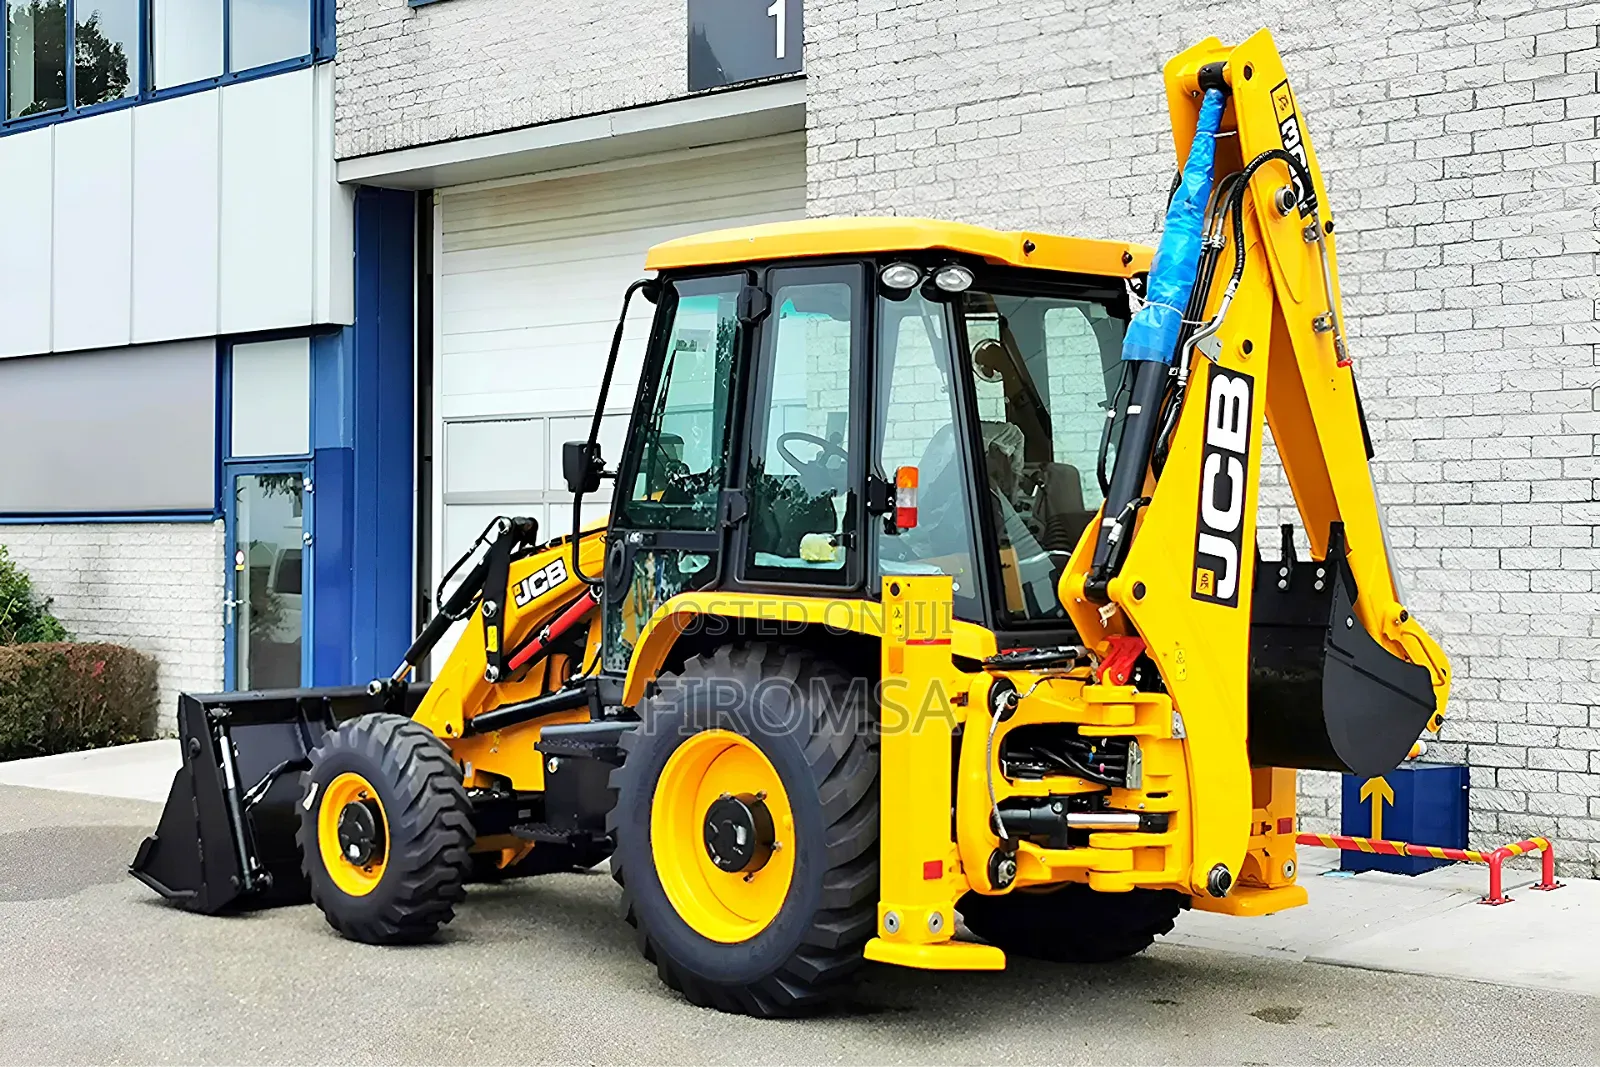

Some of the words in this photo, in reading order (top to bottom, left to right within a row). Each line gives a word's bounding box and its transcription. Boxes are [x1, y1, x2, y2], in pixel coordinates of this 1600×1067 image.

[767, 0, 786, 58] 1
[1199, 373, 1249, 600] JCB
[515, 559, 568, 606] JCB
